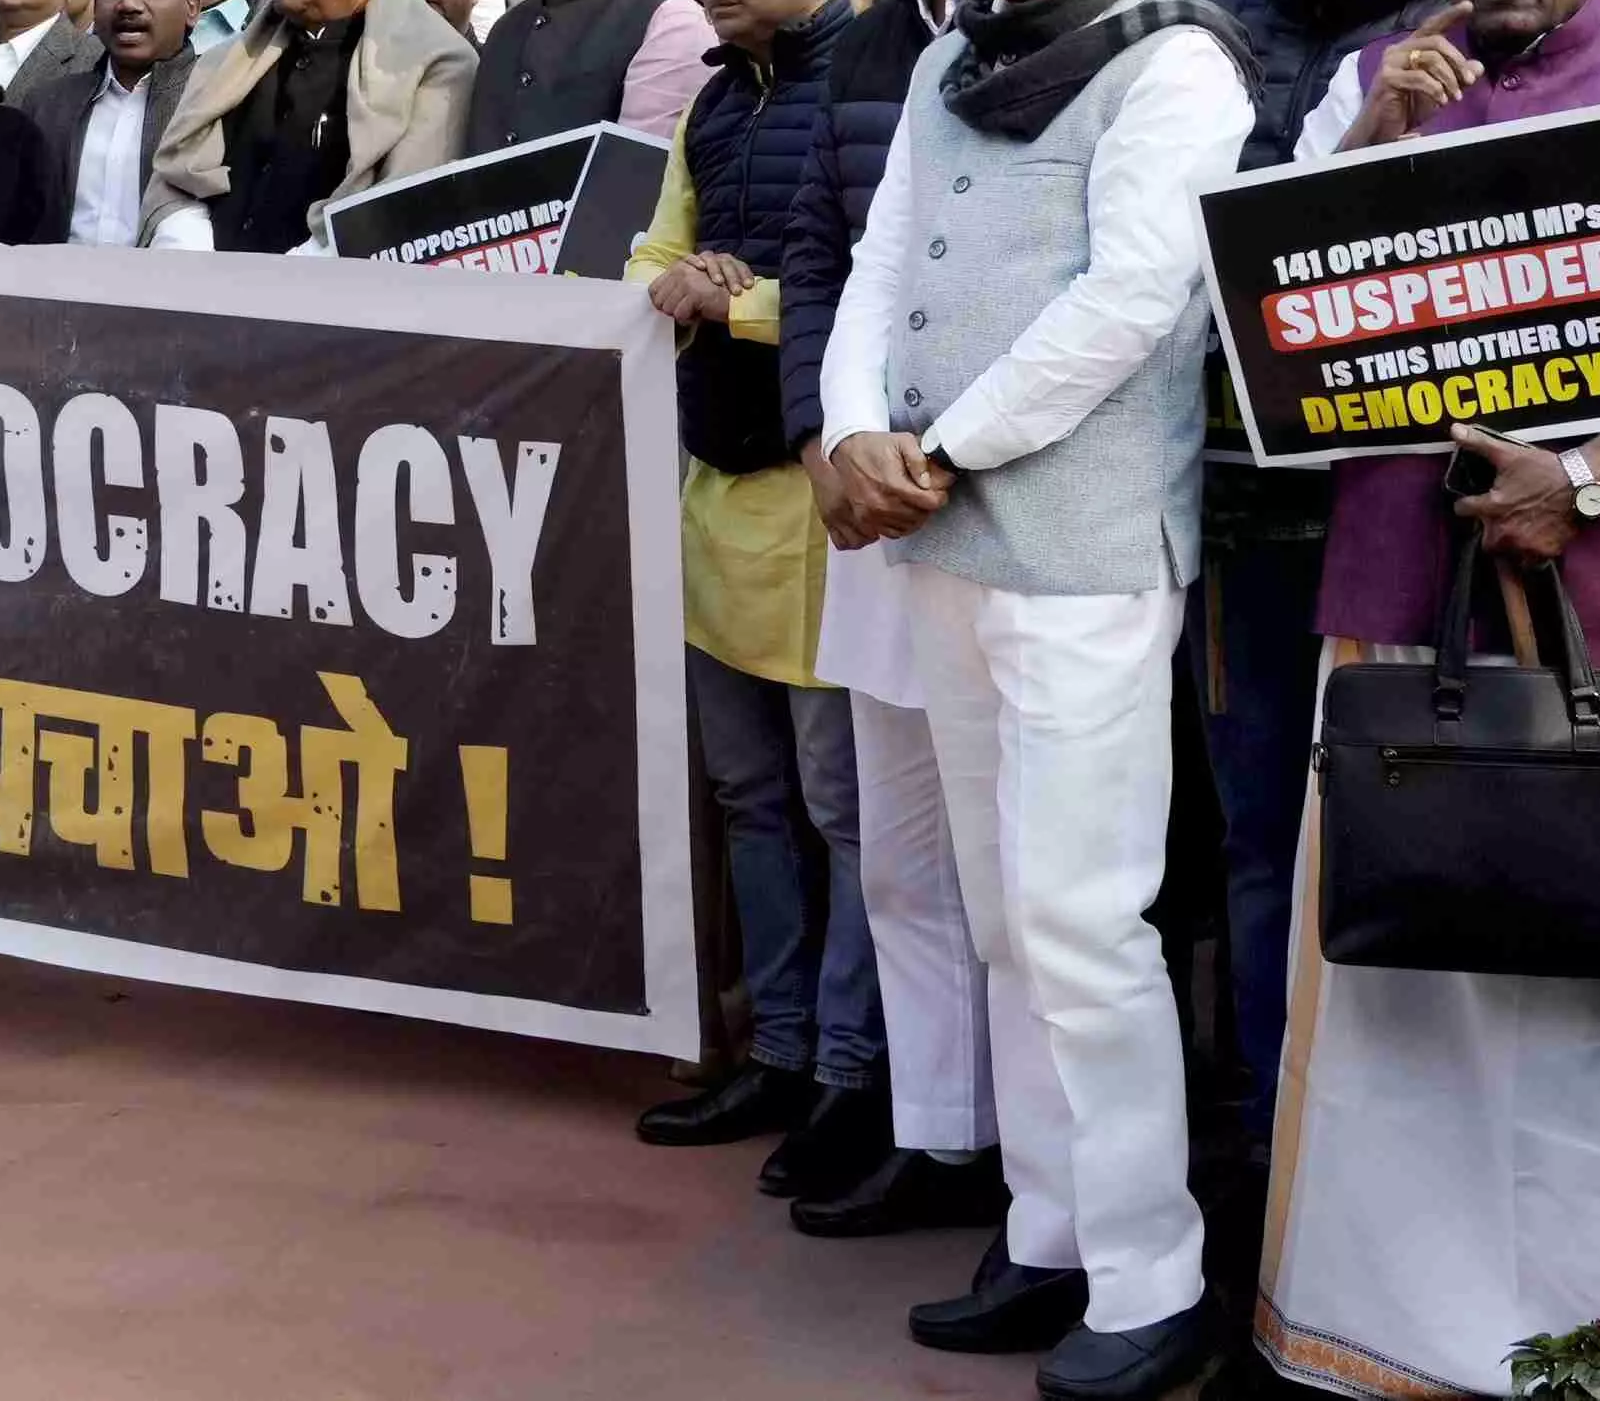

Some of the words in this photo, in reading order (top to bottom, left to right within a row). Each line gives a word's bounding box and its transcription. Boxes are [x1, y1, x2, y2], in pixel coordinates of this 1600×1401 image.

[401, 209, 529, 264] OPPOSITION
[1273, 250, 1321, 285] 141
[1328, 212, 1527, 276] OPPOSITION
[1320, 360, 1354, 388] IS
[1355, 346, 1432, 380] THIS
[1433, 325, 1562, 370] MOTHER
